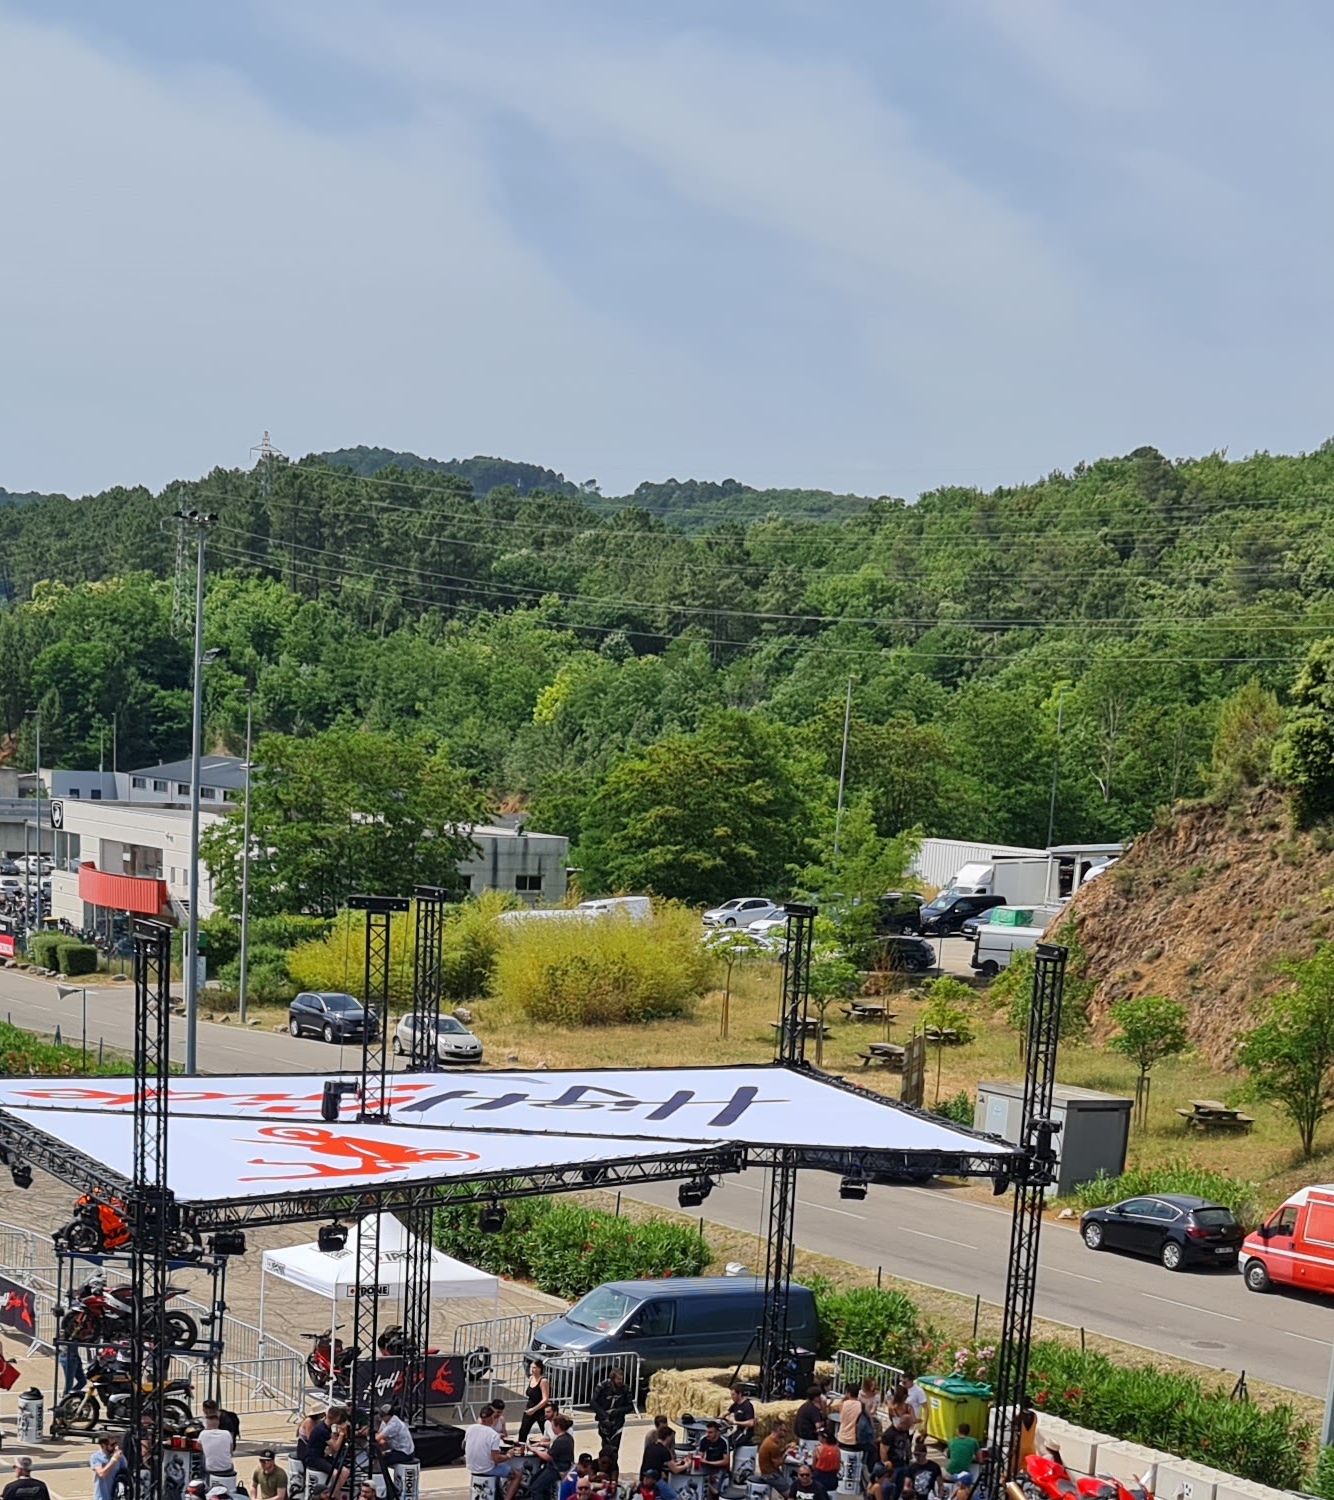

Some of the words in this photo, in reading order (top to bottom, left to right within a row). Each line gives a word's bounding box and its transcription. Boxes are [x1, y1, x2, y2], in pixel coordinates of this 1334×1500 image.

[360, 1286, 388, 1296] PONE
[846, 1456, 855, 1482] IPONE
[405, 1469, 414, 1497] IPONE
